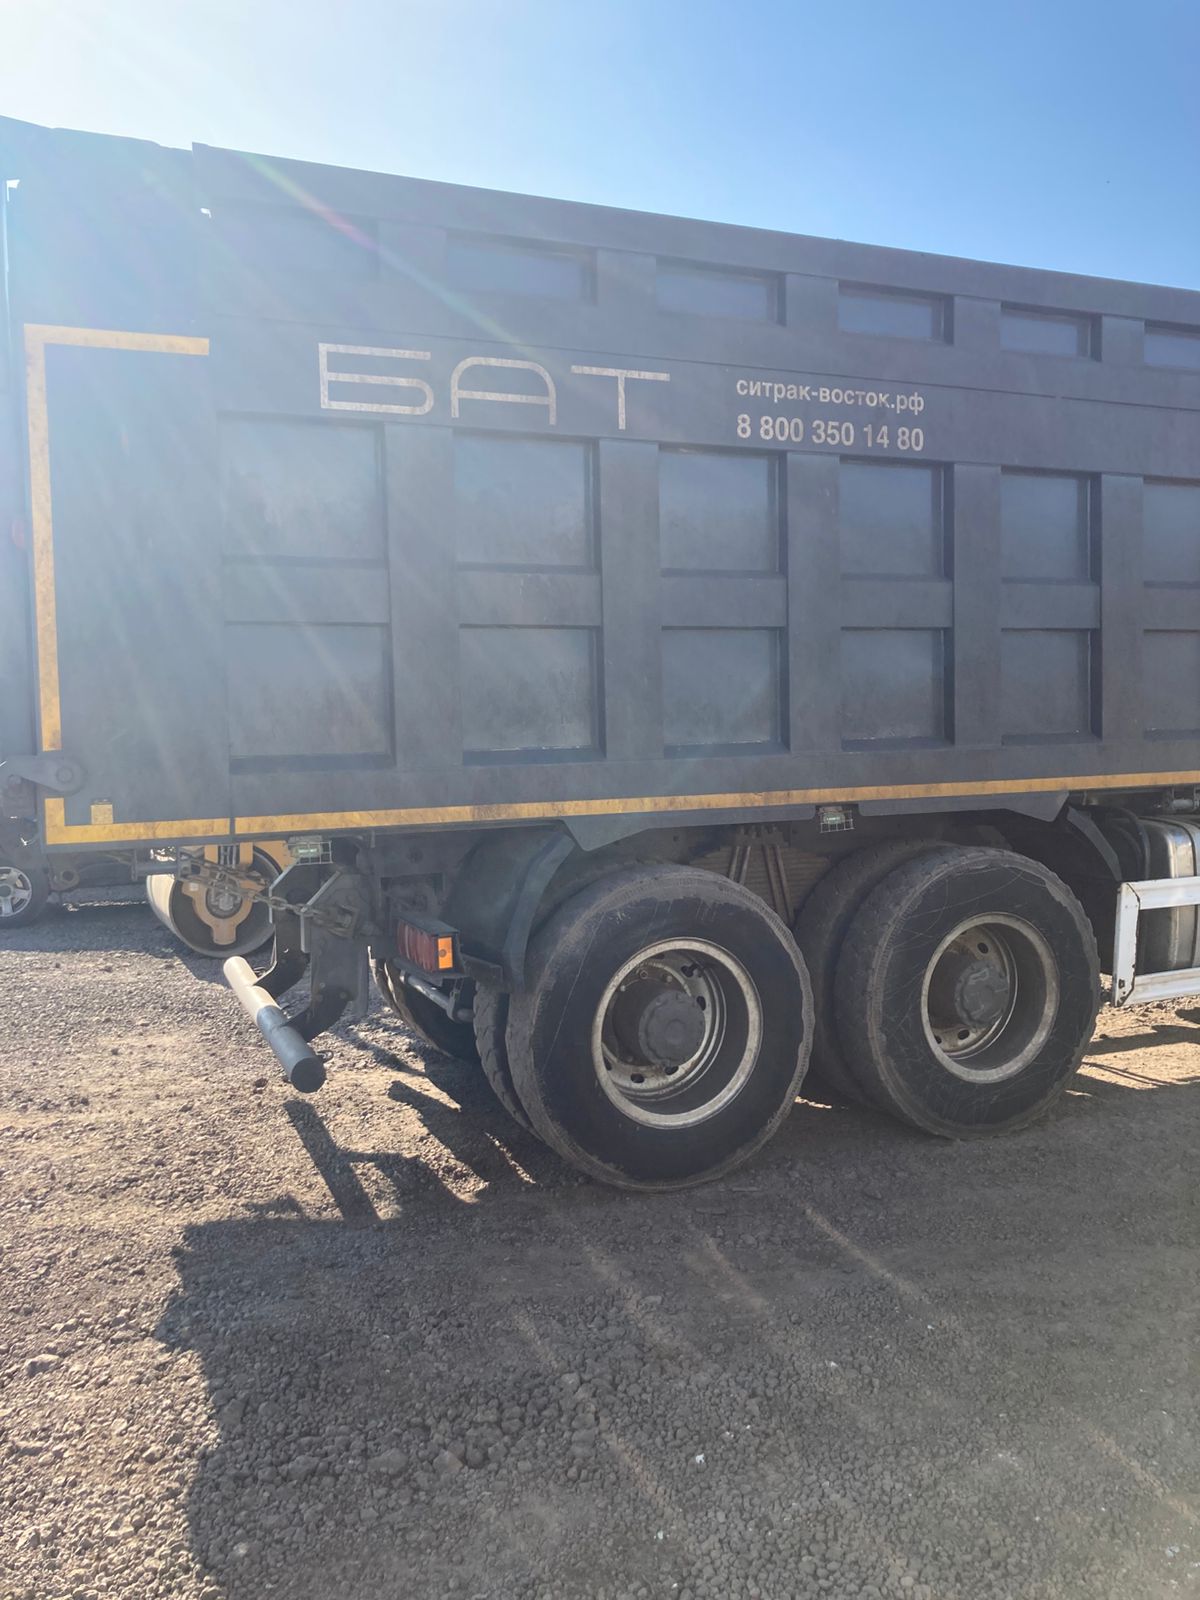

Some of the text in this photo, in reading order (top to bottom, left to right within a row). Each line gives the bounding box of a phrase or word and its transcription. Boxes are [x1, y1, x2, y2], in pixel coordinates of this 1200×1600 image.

[318, 343, 671, 430] БАТ
[736, 379, 925, 415] ситрак-восток.рф
[737, 414, 924, 451] 8 800 350 14 80
